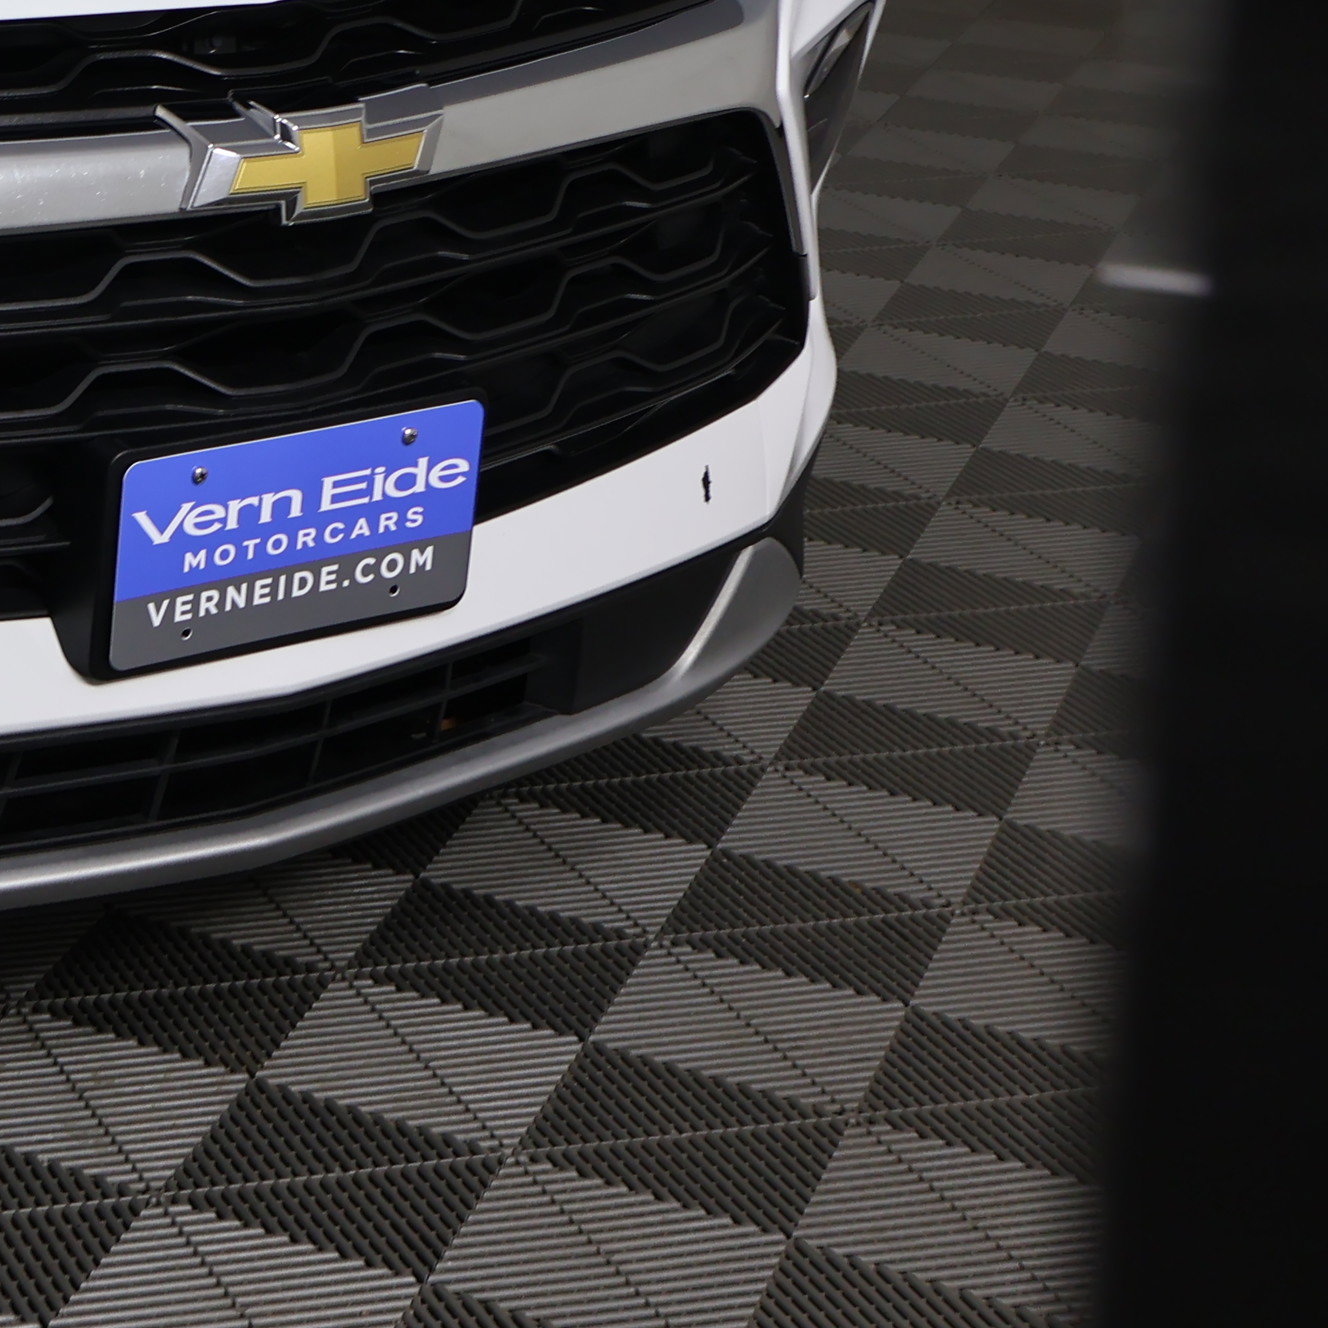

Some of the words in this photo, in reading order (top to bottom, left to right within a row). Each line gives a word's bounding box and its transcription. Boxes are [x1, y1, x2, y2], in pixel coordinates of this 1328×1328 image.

[132, 488, 303, 545] Vern
[318, 456, 470, 512] Eide
[183, 506, 425, 573] MOTORCARS
[147, 545, 435, 628] VERNEIDE.COM
